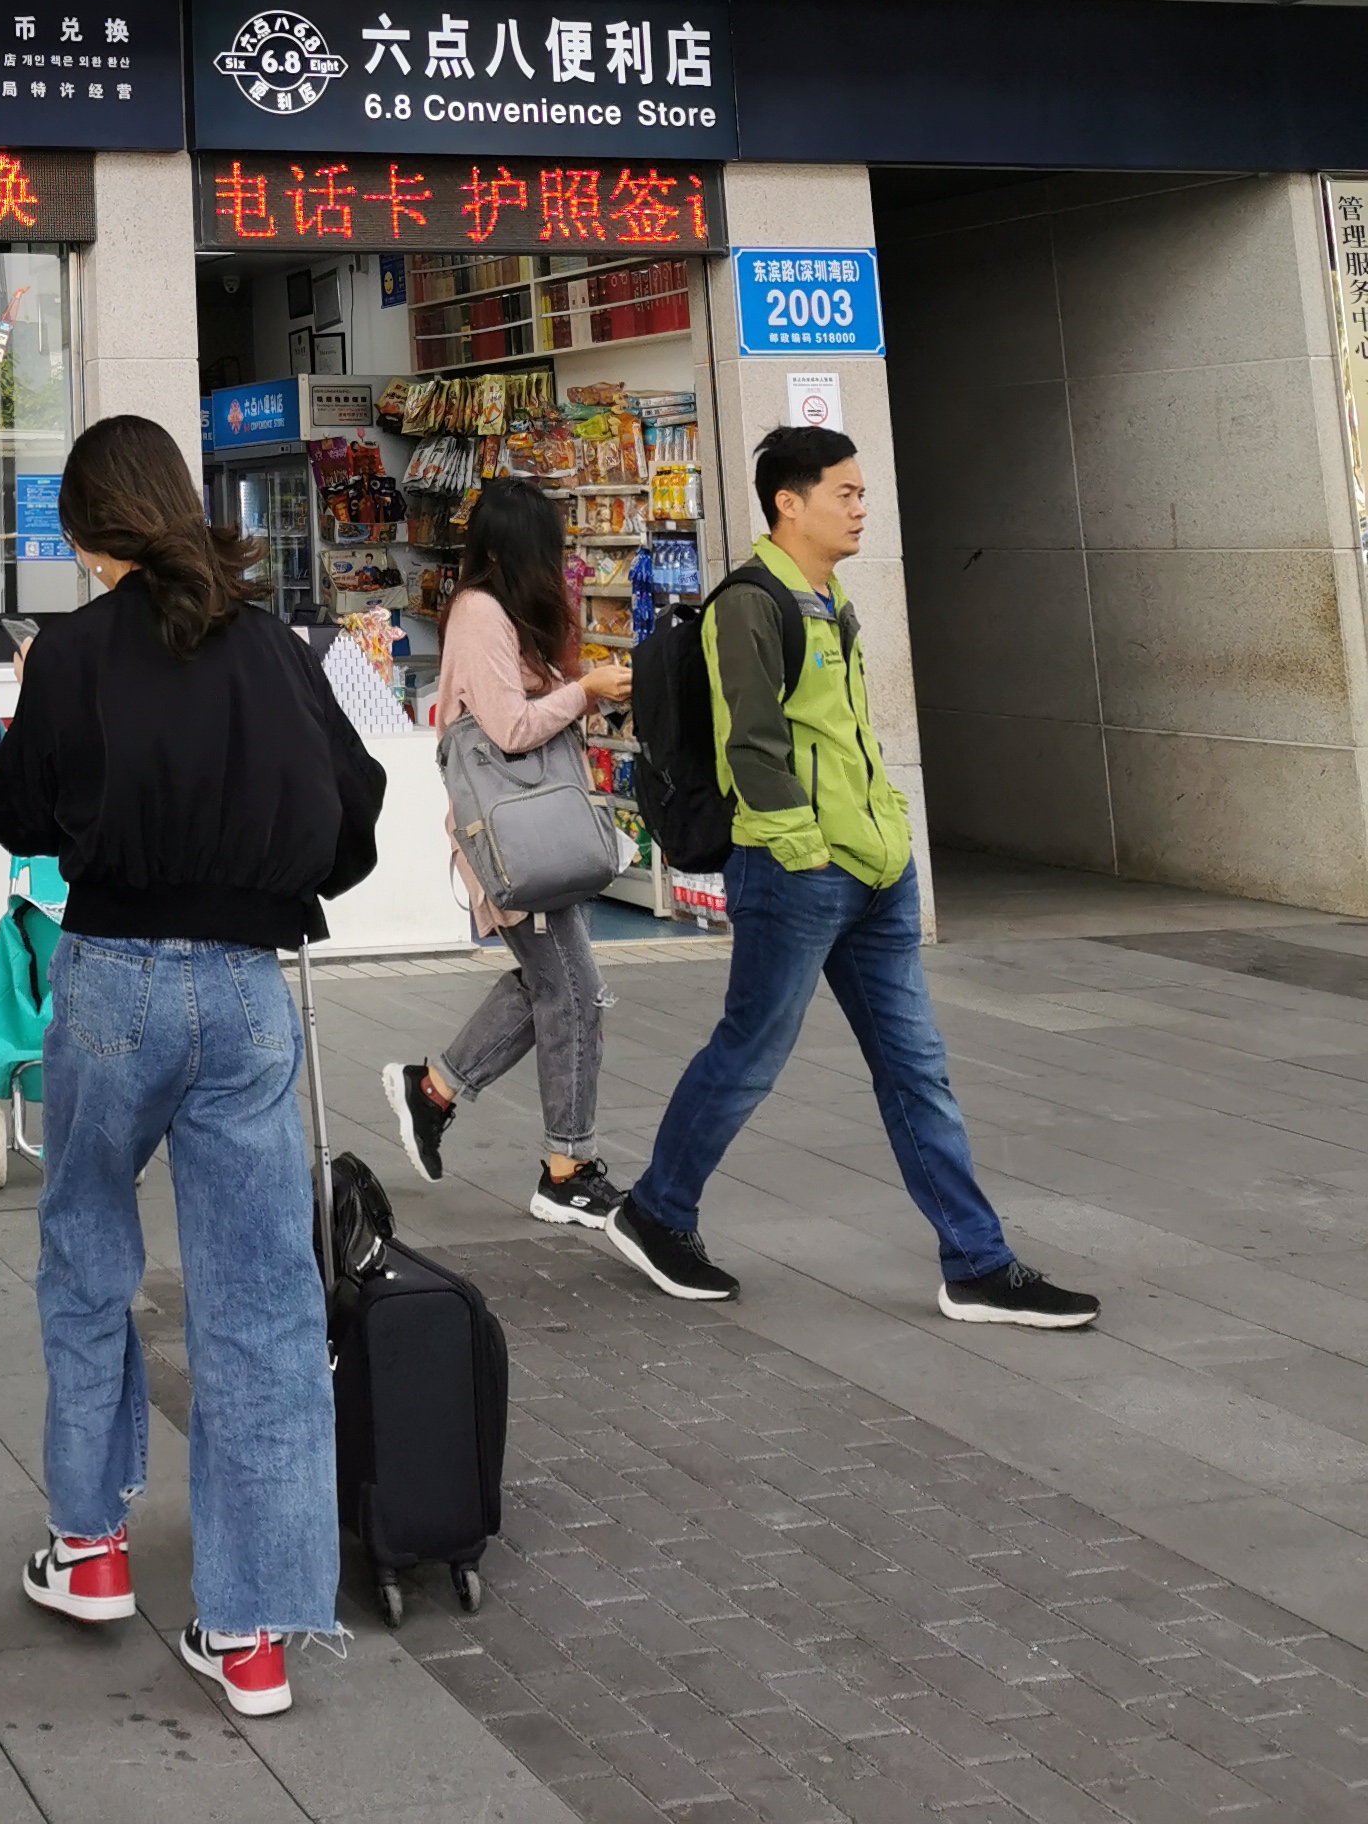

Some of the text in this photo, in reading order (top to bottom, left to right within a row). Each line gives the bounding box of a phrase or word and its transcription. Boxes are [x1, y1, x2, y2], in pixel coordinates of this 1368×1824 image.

[225, 49, 340, 74] Six 6.8 Eight
[361, 12, 713, 87] 六点八便利店
[363, 93, 717, 128] 6.8 Convenience Store
[215, 161, 434, 239] 电话卡
[752, 259, 860, 283] 东滨路(深圳湾段)
[766, 288, 854, 327] 2003
[768, 332, 856, 344] 邮政编码 518000
